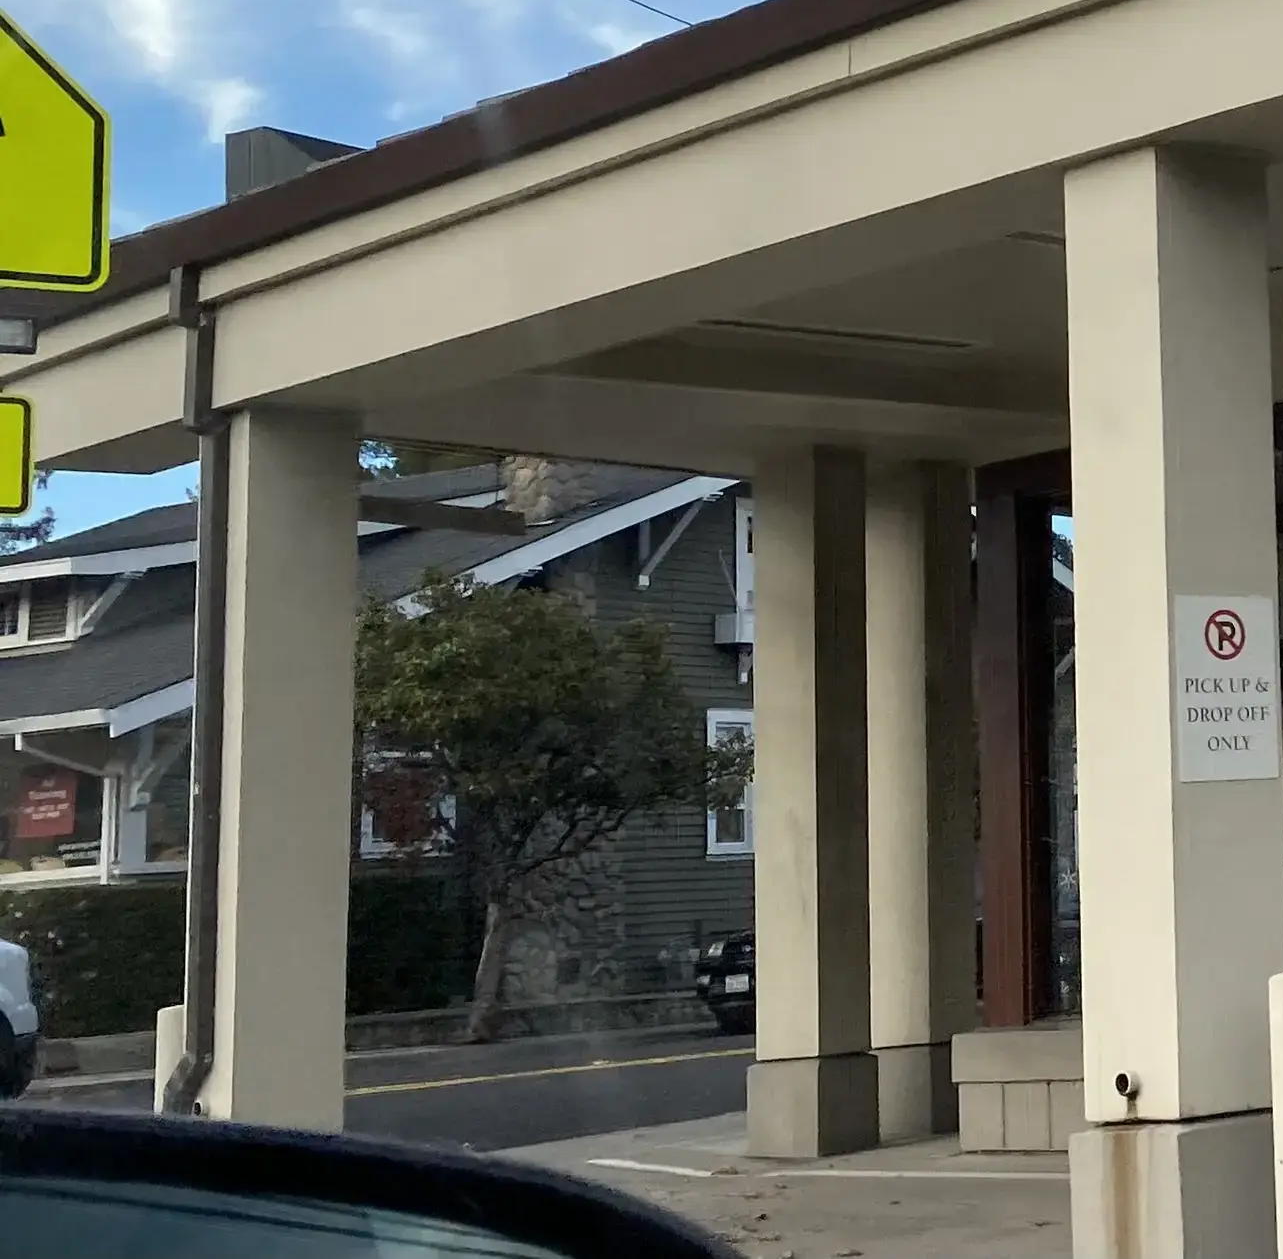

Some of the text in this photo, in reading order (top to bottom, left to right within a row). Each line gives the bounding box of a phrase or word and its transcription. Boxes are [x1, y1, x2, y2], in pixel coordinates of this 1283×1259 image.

[1184, 677, 1270, 694] PICK UP &
[1186, 706, 1270, 723] DROP OFF
[1206, 735, 1252, 752] ONLY
